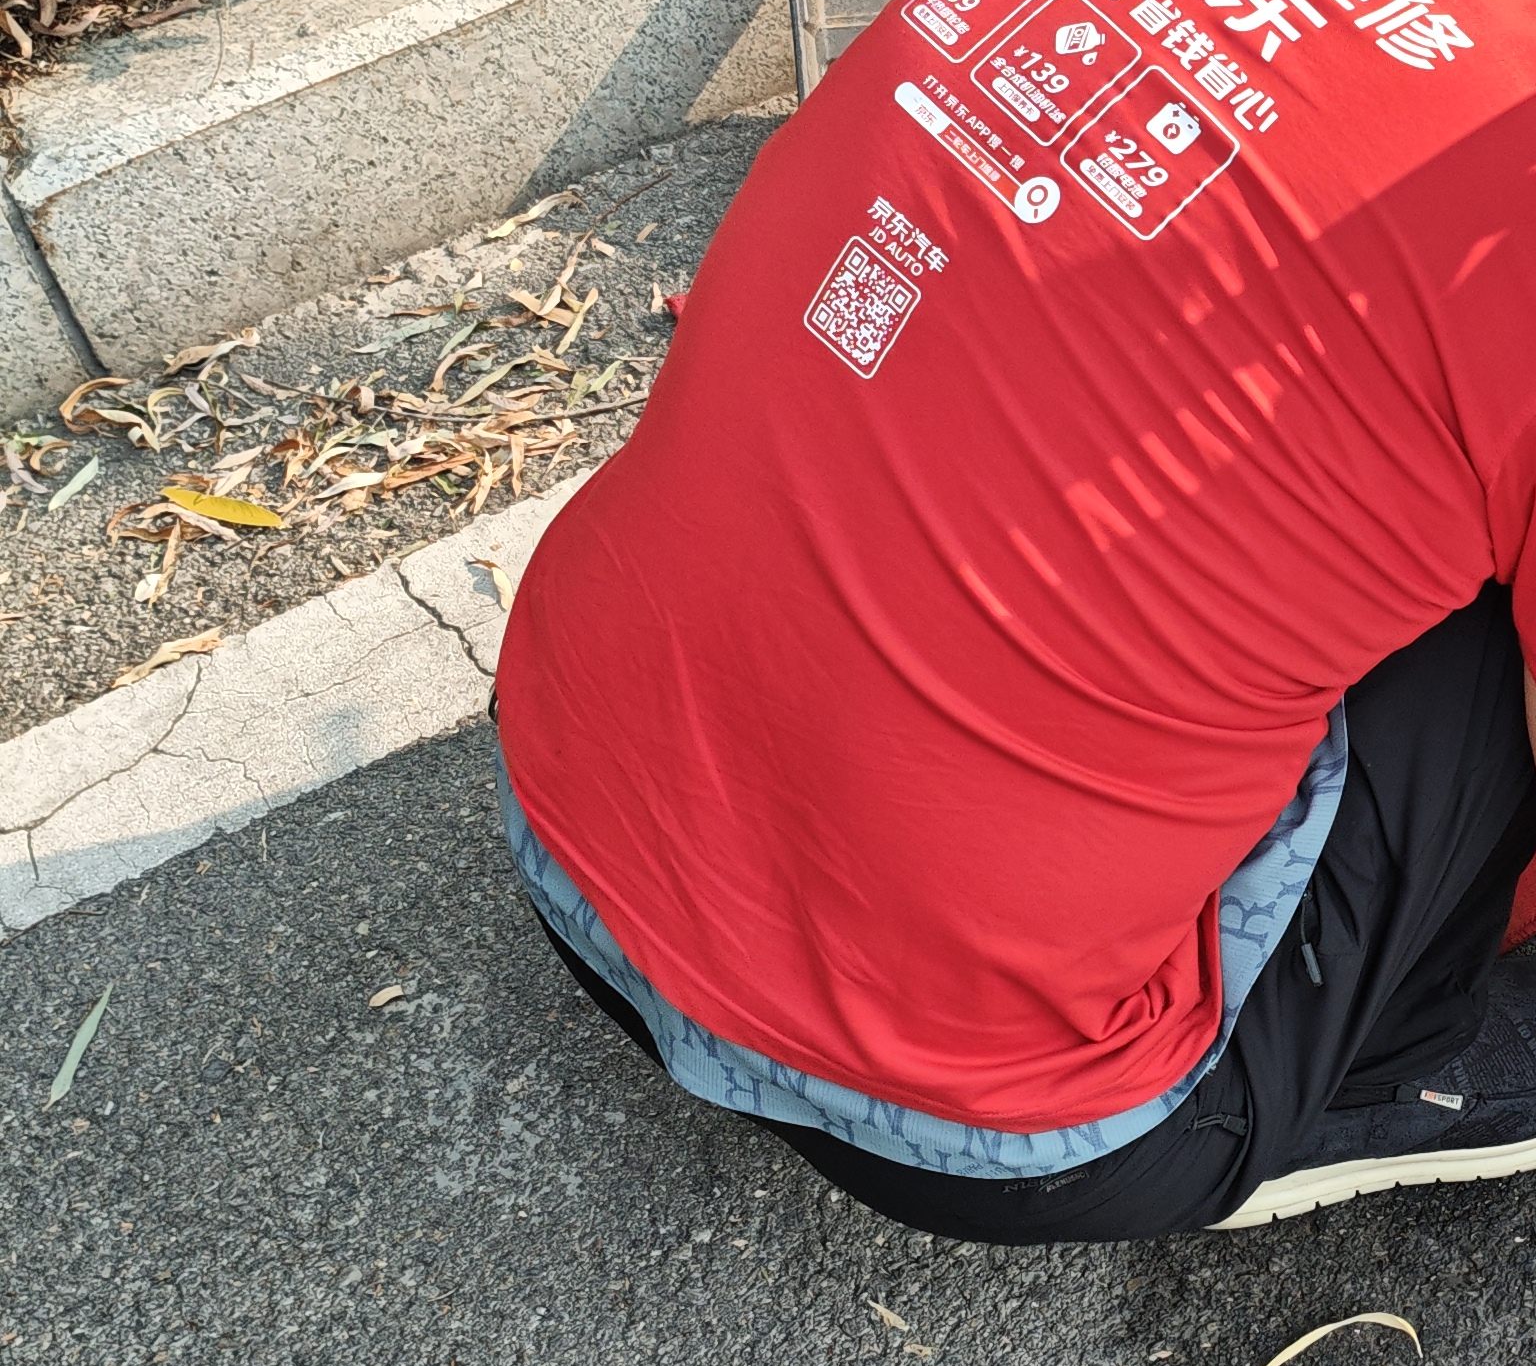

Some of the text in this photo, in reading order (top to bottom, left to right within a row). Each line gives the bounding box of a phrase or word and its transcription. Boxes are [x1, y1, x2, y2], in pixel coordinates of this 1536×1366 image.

[1070, 27, 1085, 49] OIL
[1013, 45, 1070, 94] ¥139
[1104, 130, 1169, 187] ¥279
[867, 195, 950, 273] 京东汽车
[868, 226, 924, 277] JD AUTO
